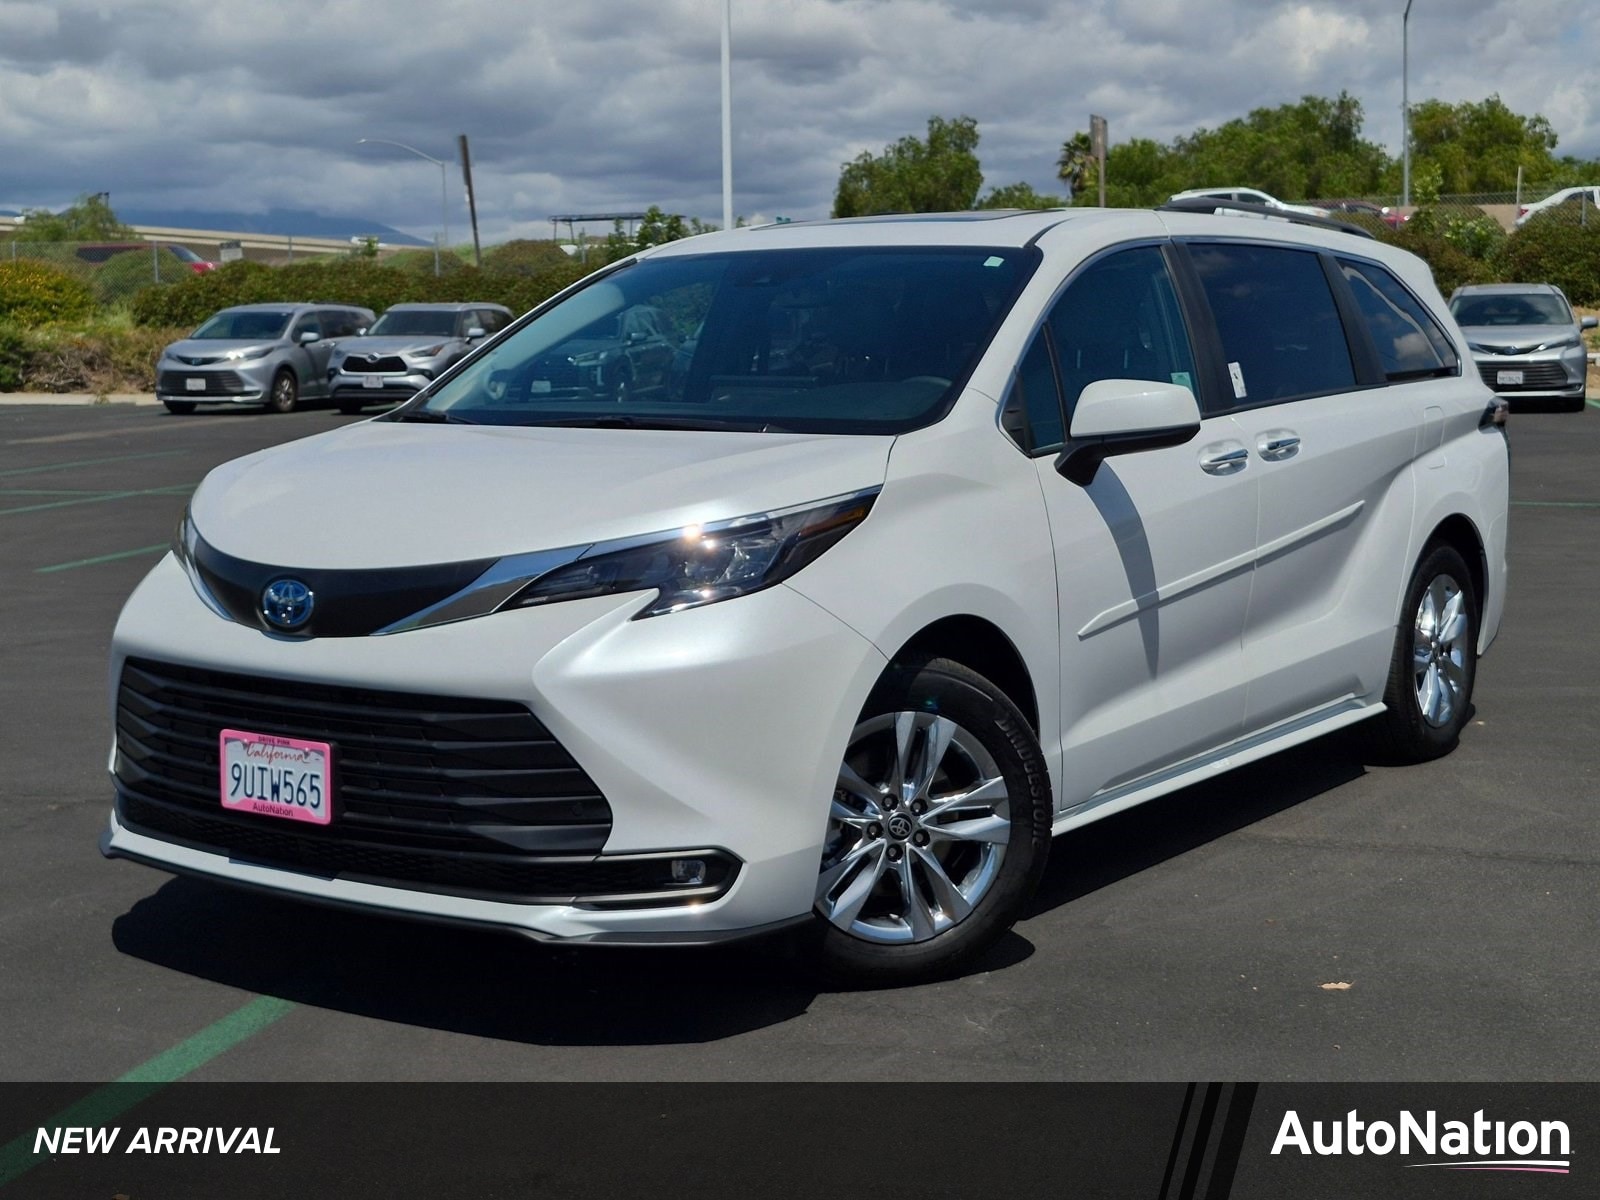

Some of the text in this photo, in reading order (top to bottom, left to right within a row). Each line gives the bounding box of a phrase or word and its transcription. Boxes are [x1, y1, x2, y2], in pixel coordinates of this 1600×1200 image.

[246, 741, 310, 764] California
[230, 763, 321, 809] 9UIW565
[252, 802, 294, 817] AutoNation
